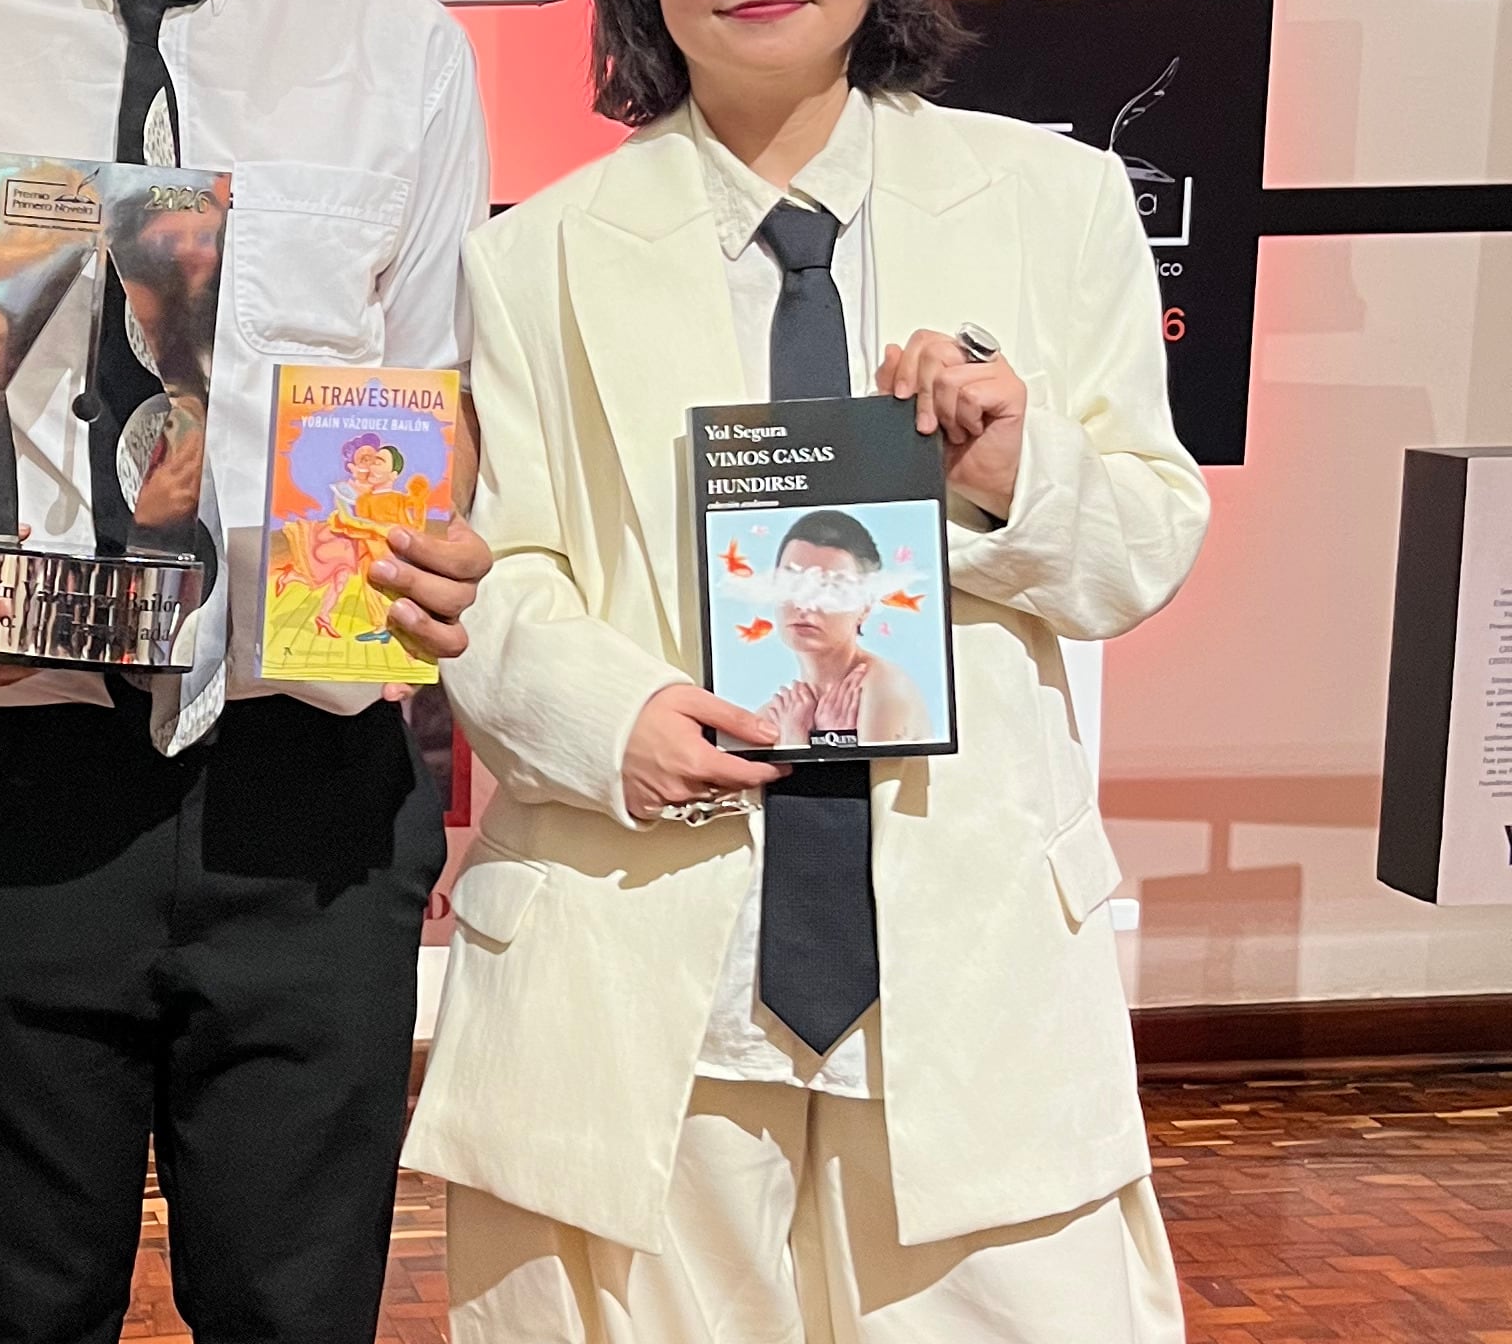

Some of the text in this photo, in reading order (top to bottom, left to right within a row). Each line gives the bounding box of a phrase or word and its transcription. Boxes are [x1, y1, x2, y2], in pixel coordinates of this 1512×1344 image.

[14, 189, 50, 200] Premio
[12, 200, 92, 215] Primera Novela
[293, 385, 444, 409] LA TRAVESTIADA
[343, 415, 387, 430] VÁZQUEZ
[705, 425, 788, 442] Yol Segura
[706, 447, 835, 467] VIMOS CASAS
[708, 475, 808, 494] HUNDIRSE
